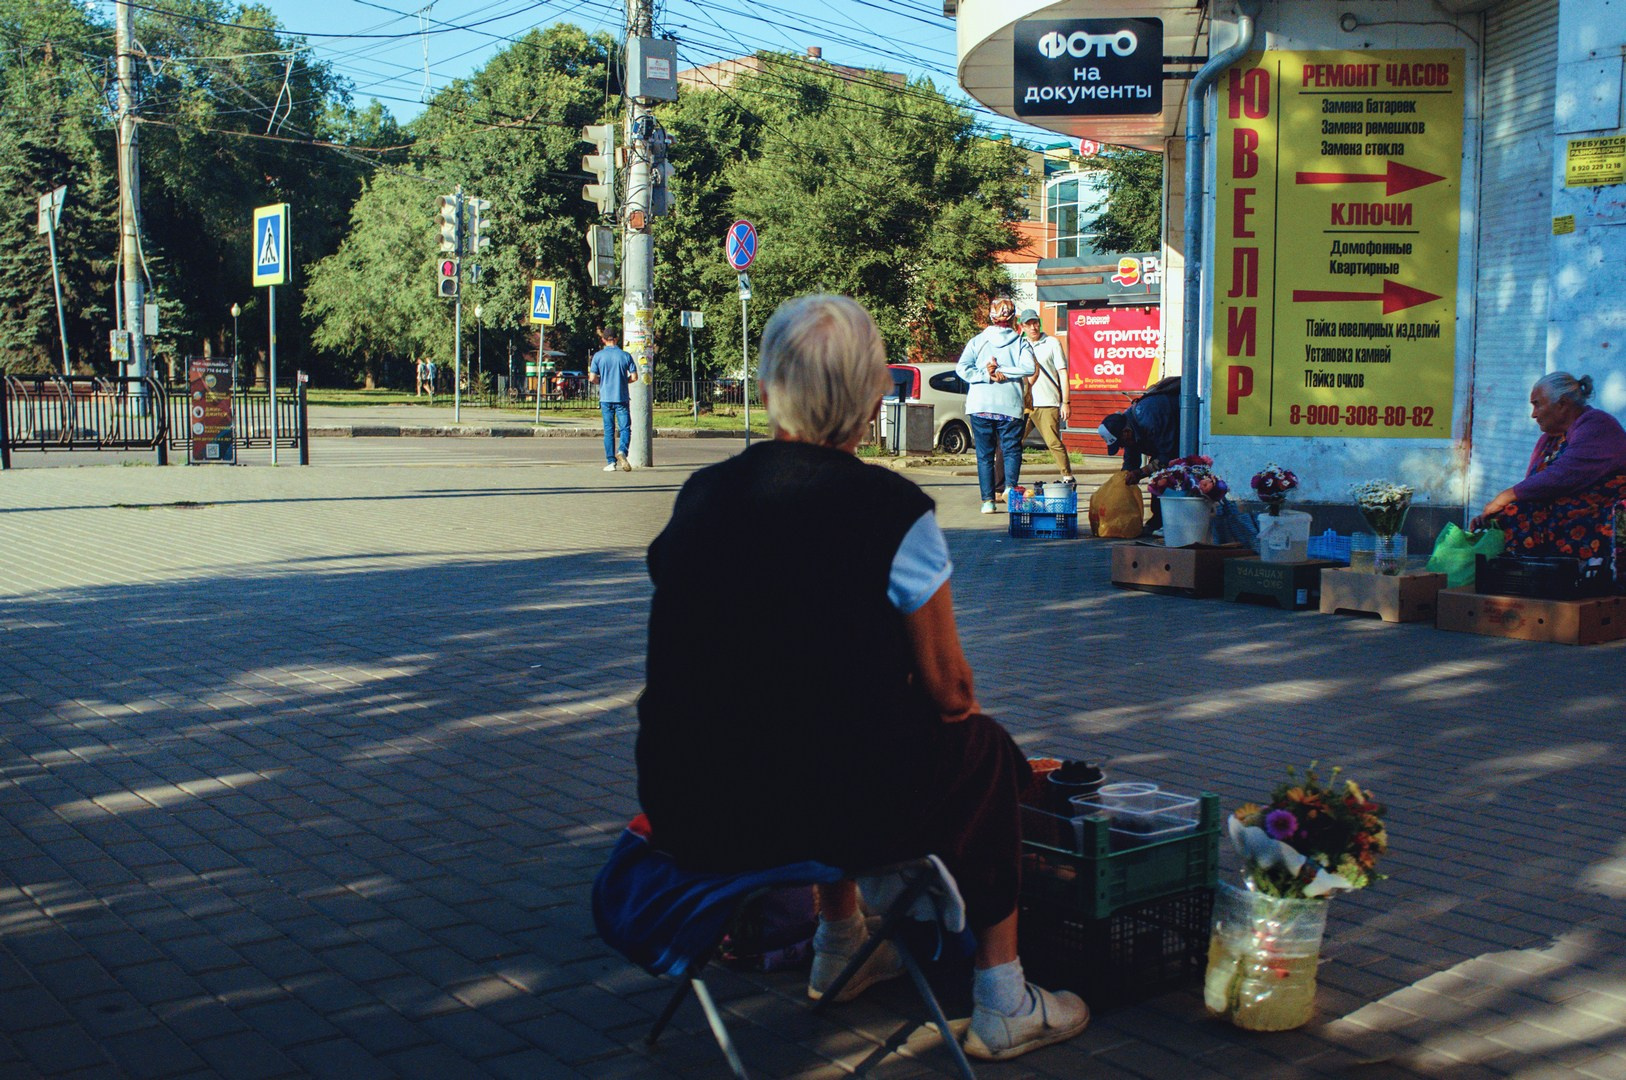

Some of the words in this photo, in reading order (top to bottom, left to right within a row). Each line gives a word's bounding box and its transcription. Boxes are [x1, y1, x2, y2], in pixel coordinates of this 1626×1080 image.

[1038, 30, 1138, 59] ФОТО
[1073, 67, 1101, 81] на
[1302, 64, 1380, 87] РЕМОНТ
[1386, 63, 1449, 86] ЧАСОВ
[1024, 85, 1152, 104] документы
[1322, 99, 1363, 113] Замена
[1366, 99, 1416, 115] батареек
[1321, 120, 1363, 134] Замена
[1365, 121, 1425, 136] ремешков
[1321, 141, 1363, 155] Замена
[1365, 142, 1404, 156] стекла
[1571, 138, 1625, 149] ТРЕБУЮТСЯ
[1331, 203, 1413, 226] КЛЮЧИ
[1227, 68, 1270, 415] ЮВЕЛИР
[1330, 240, 1413, 256] Домофонные
[1329, 260, 1400, 276] Квартирные
[1306, 319, 1336, 338] Пайка
[1338, 321, 1394, 340] ювелирных
[1396, 320, 1440, 341] изделий
[1094, 348, 1105, 359] и
[1305, 345, 1353, 363] Установка
[1355, 345, 1391, 363] камней
[1094, 360, 1125, 376] еда
[1304, 370, 1335, 388] Пайка
[1337, 372, 1364, 388] очков
[1290, 404, 1434, 427] 8-900-308-80-82
[1237, 567, 1285, 580] КУЛЬТУРА
